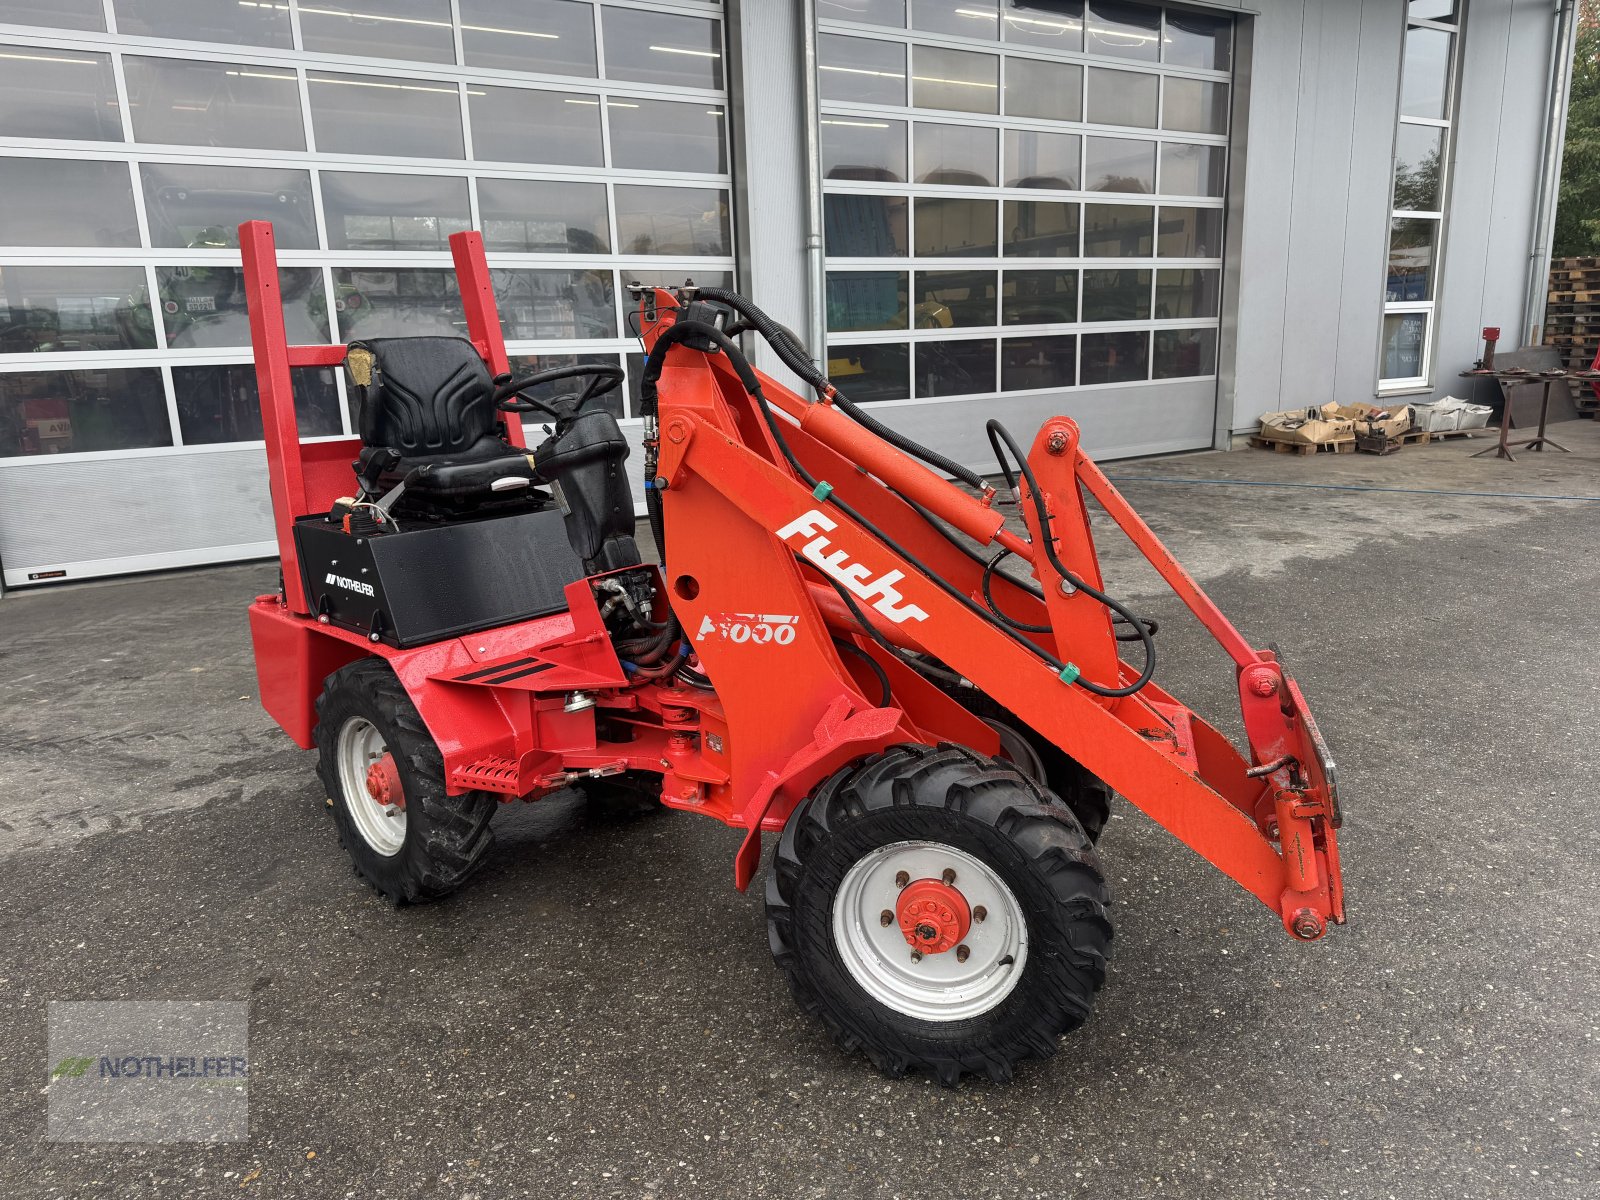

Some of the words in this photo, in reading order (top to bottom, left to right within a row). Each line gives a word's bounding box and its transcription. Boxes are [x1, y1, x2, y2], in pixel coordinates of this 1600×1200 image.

[49, 423, 69, 432] AVI
[774, 509, 931, 623] Fuchs
[336, 575, 375, 597] NOTHELFER
[695, 614, 797, 645] A000
